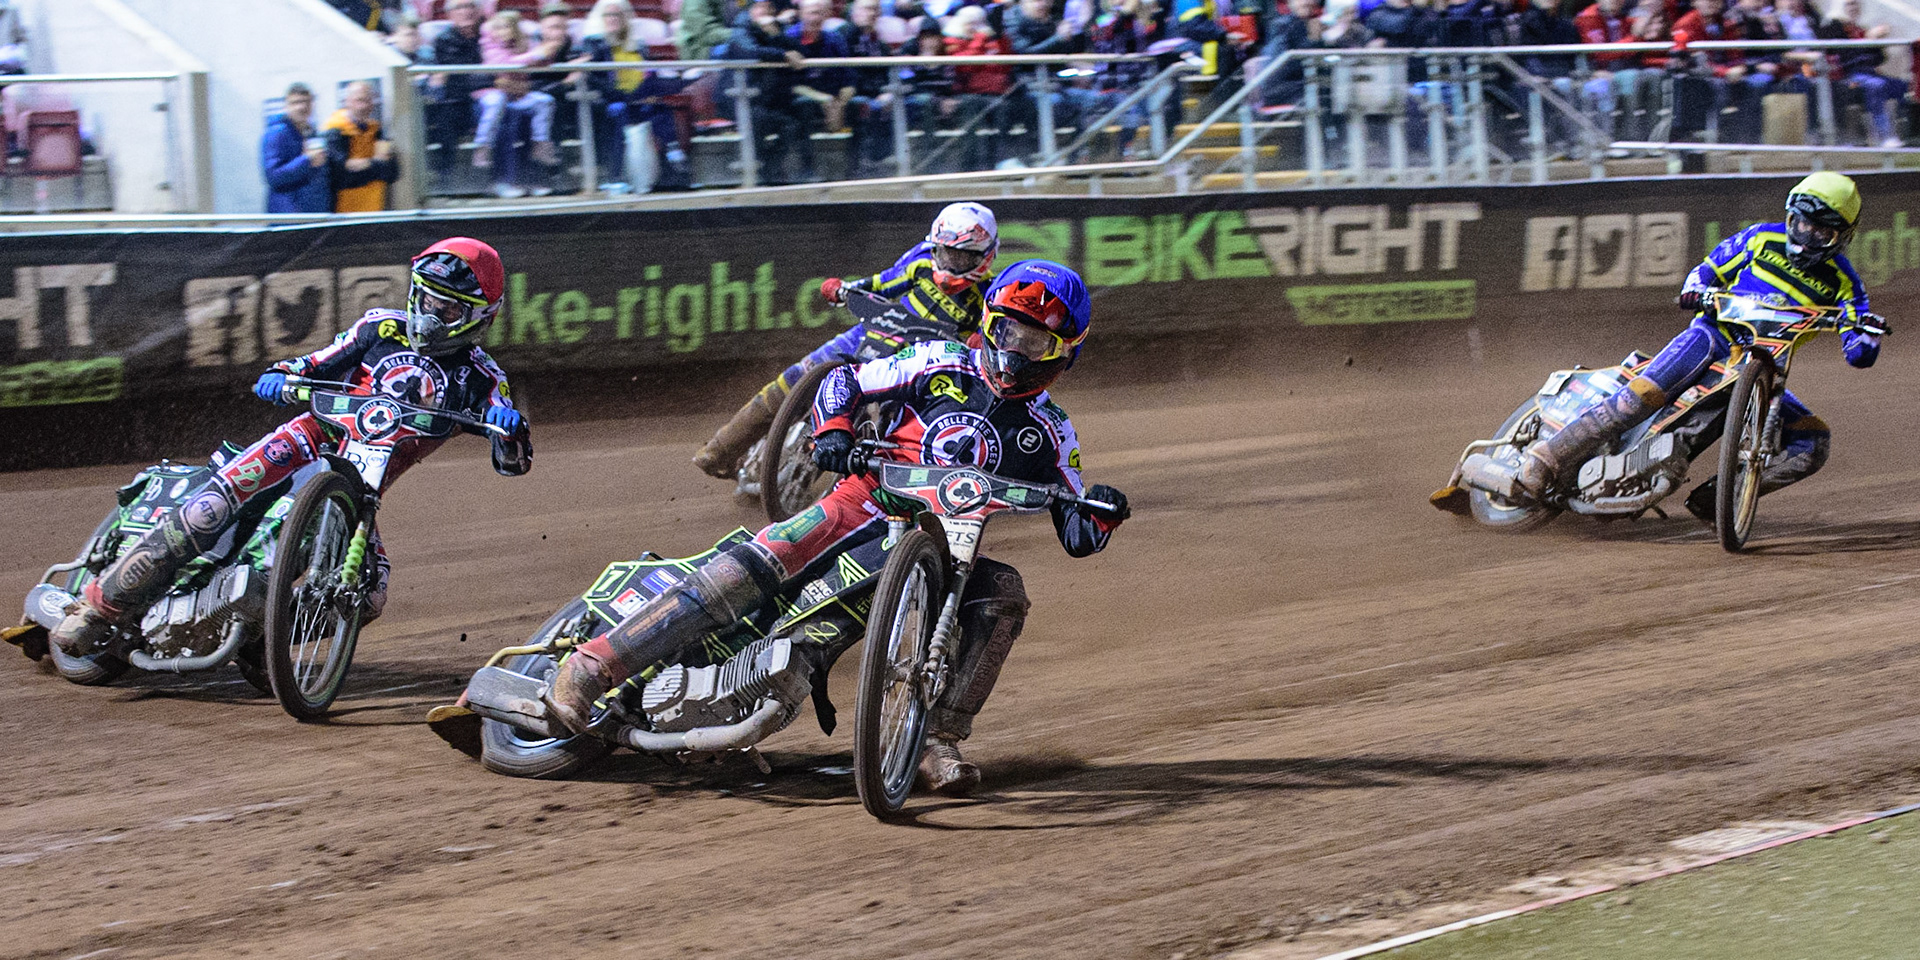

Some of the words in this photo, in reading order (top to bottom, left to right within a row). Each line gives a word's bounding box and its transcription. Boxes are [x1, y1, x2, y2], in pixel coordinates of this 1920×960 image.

[383, 355, 415, 370] BELLE
[419, 358, 439, 375] VUE
[937, 416, 969, 430] BELLE
[972, 417, 991, 437] VUE
[987, 439, 998, 465] ACES
